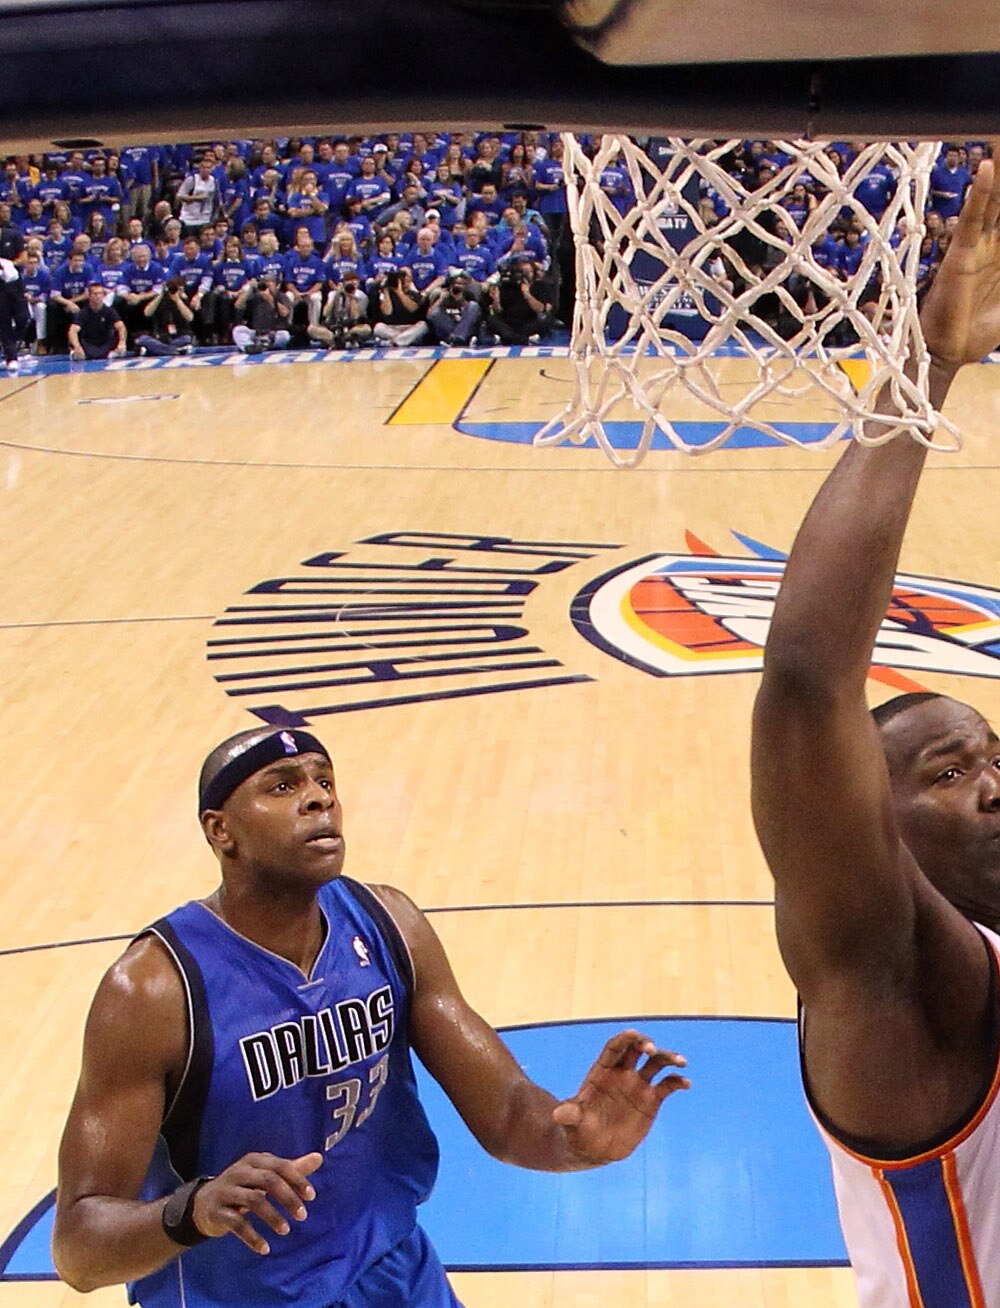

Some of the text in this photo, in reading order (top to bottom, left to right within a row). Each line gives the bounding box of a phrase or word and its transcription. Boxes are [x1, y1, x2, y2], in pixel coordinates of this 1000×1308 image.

[104, 346, 573, 371] OKLAHOMA
[206, 531, 627, 727] THUNDER
[238, 984, 395, 1102] DALLAS
[324, 1053, 390, 1152] 33
